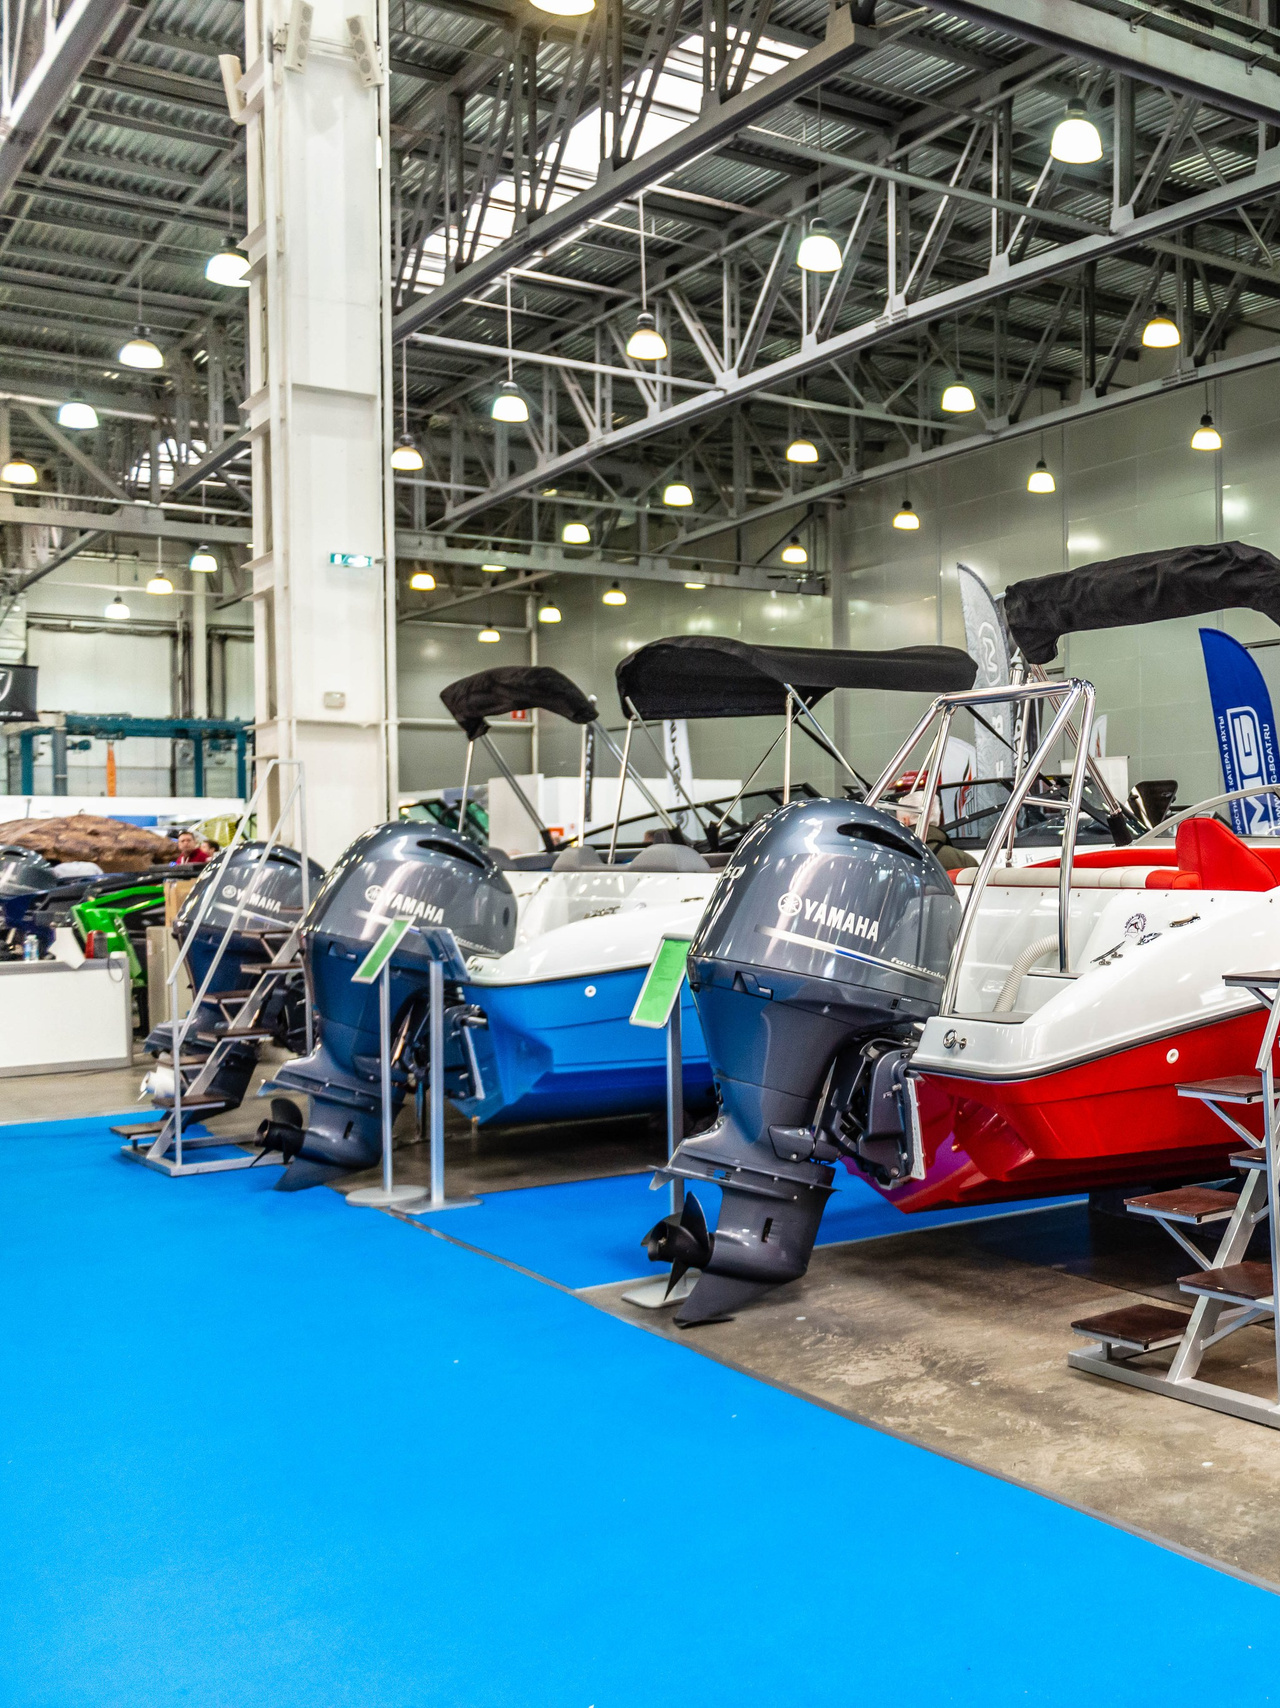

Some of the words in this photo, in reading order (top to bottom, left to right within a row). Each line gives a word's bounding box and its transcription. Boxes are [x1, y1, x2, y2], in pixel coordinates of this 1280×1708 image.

[1219, 716, 1228, 742] ЯХТЫ
[1224, 751, 1233, 787] КАТЕРА
[237, 888, 282, 913] YMAHA
[386, 892, 445, 925] YAMAHA
[804, 898, 880, 942] YAMAHA
